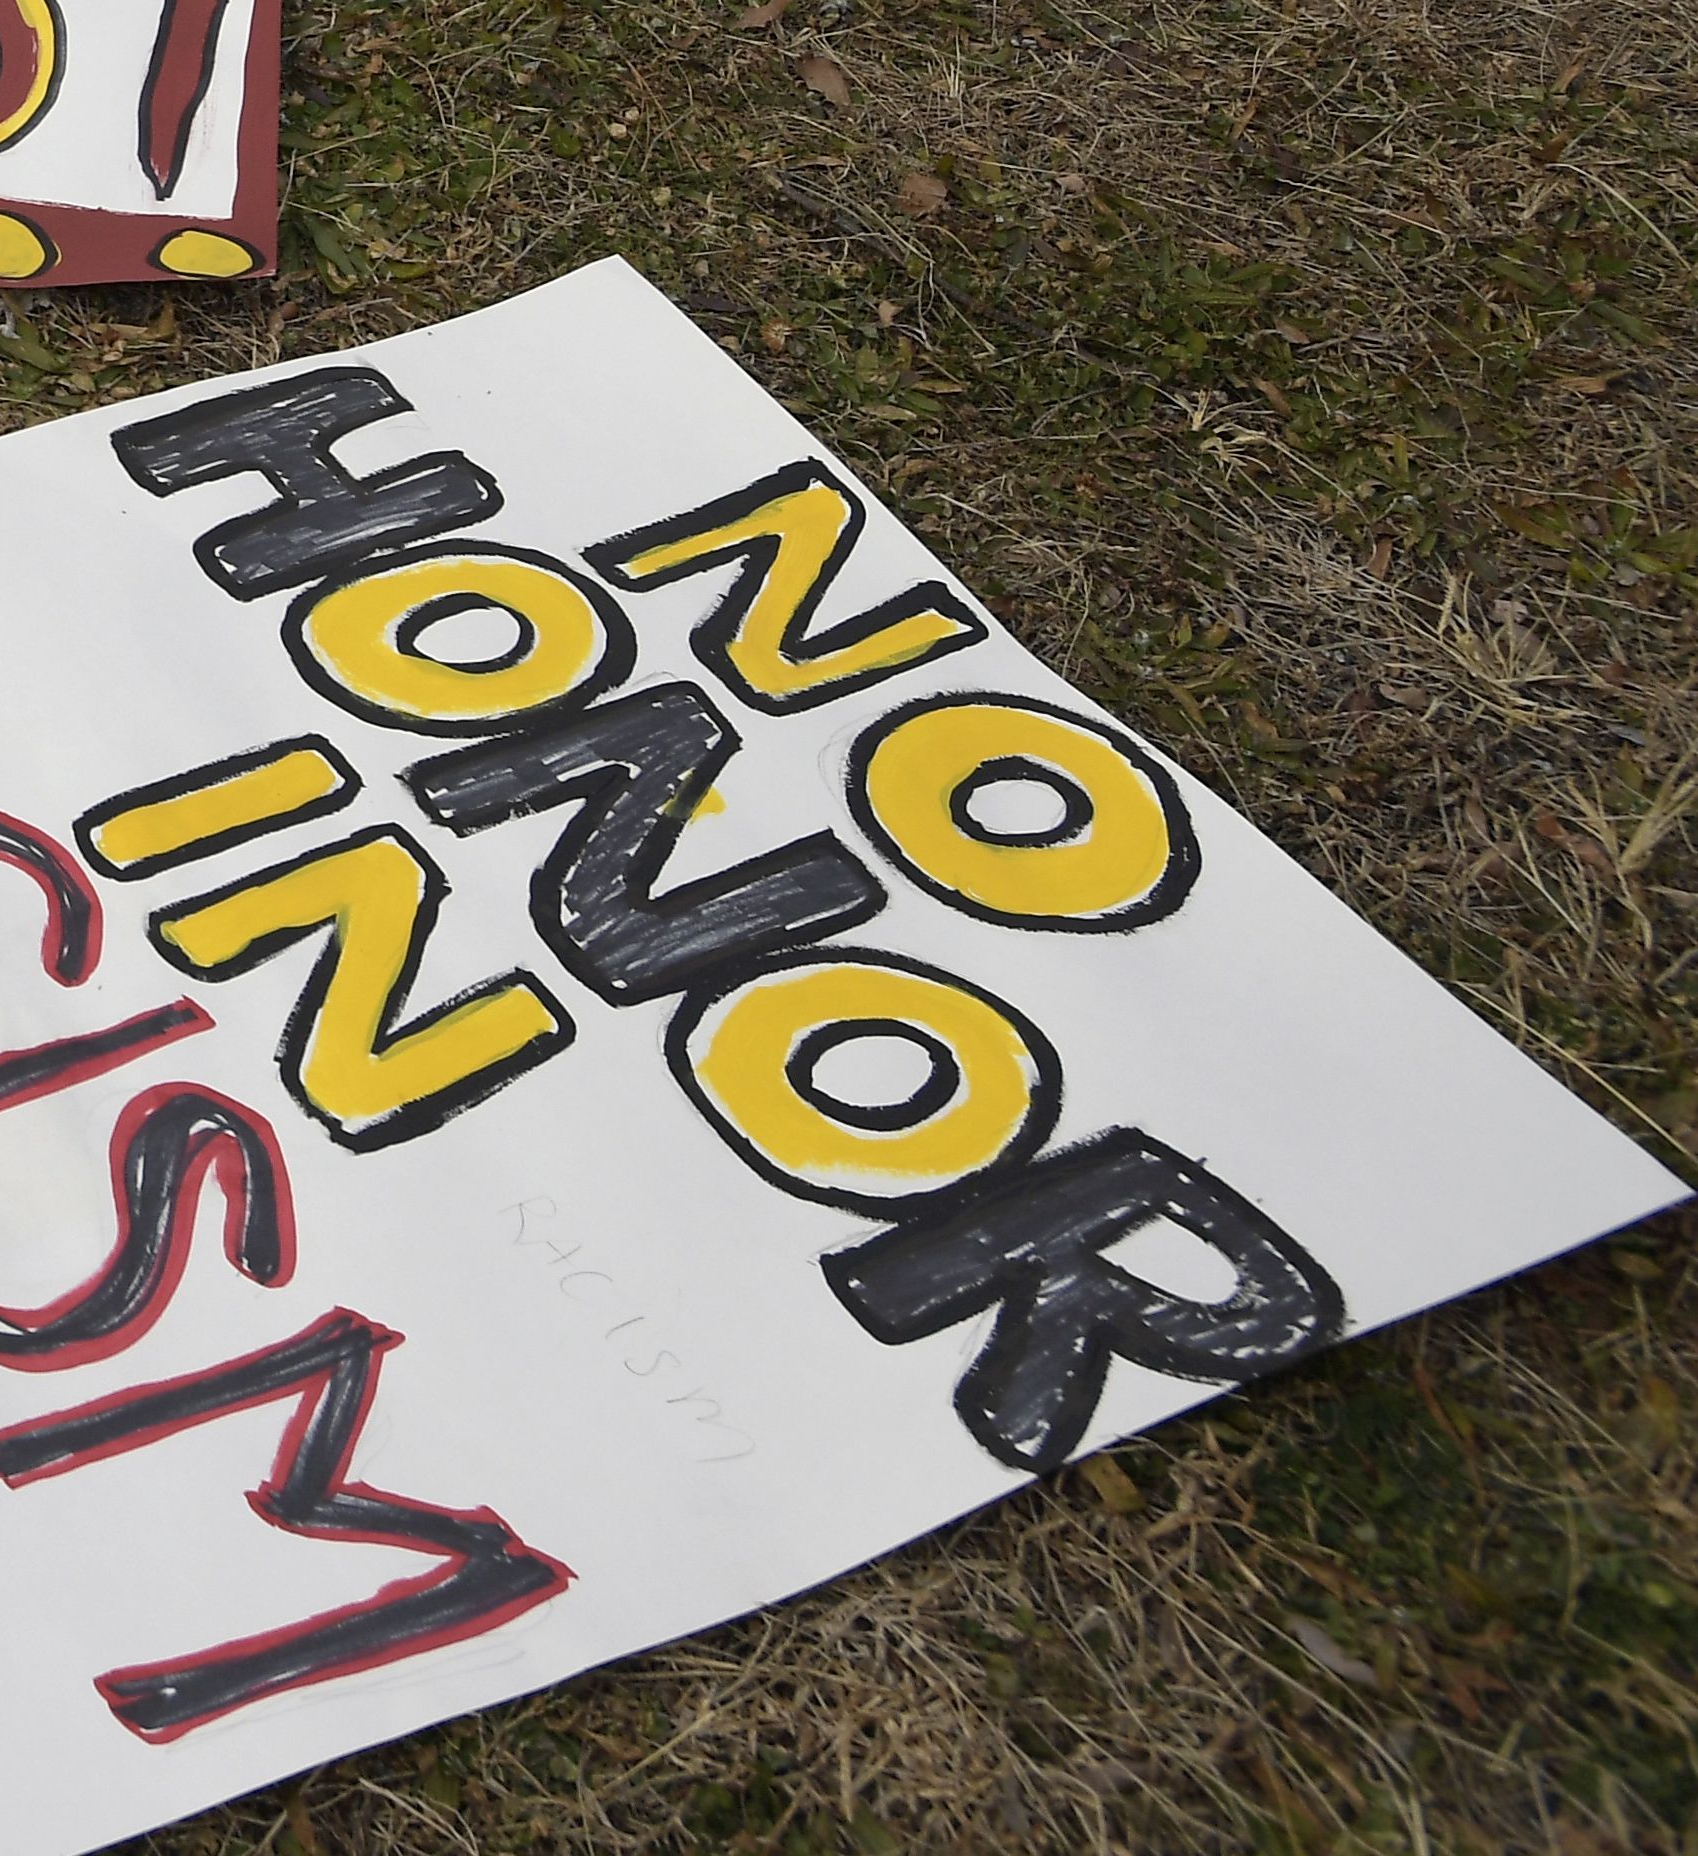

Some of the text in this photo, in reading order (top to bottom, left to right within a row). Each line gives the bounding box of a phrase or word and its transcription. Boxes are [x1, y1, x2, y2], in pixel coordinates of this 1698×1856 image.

[108, 365, 1347, 1478] HONOR
[598, 458, 1204, 936] NO
[74, 735, 576, 1154] IN
